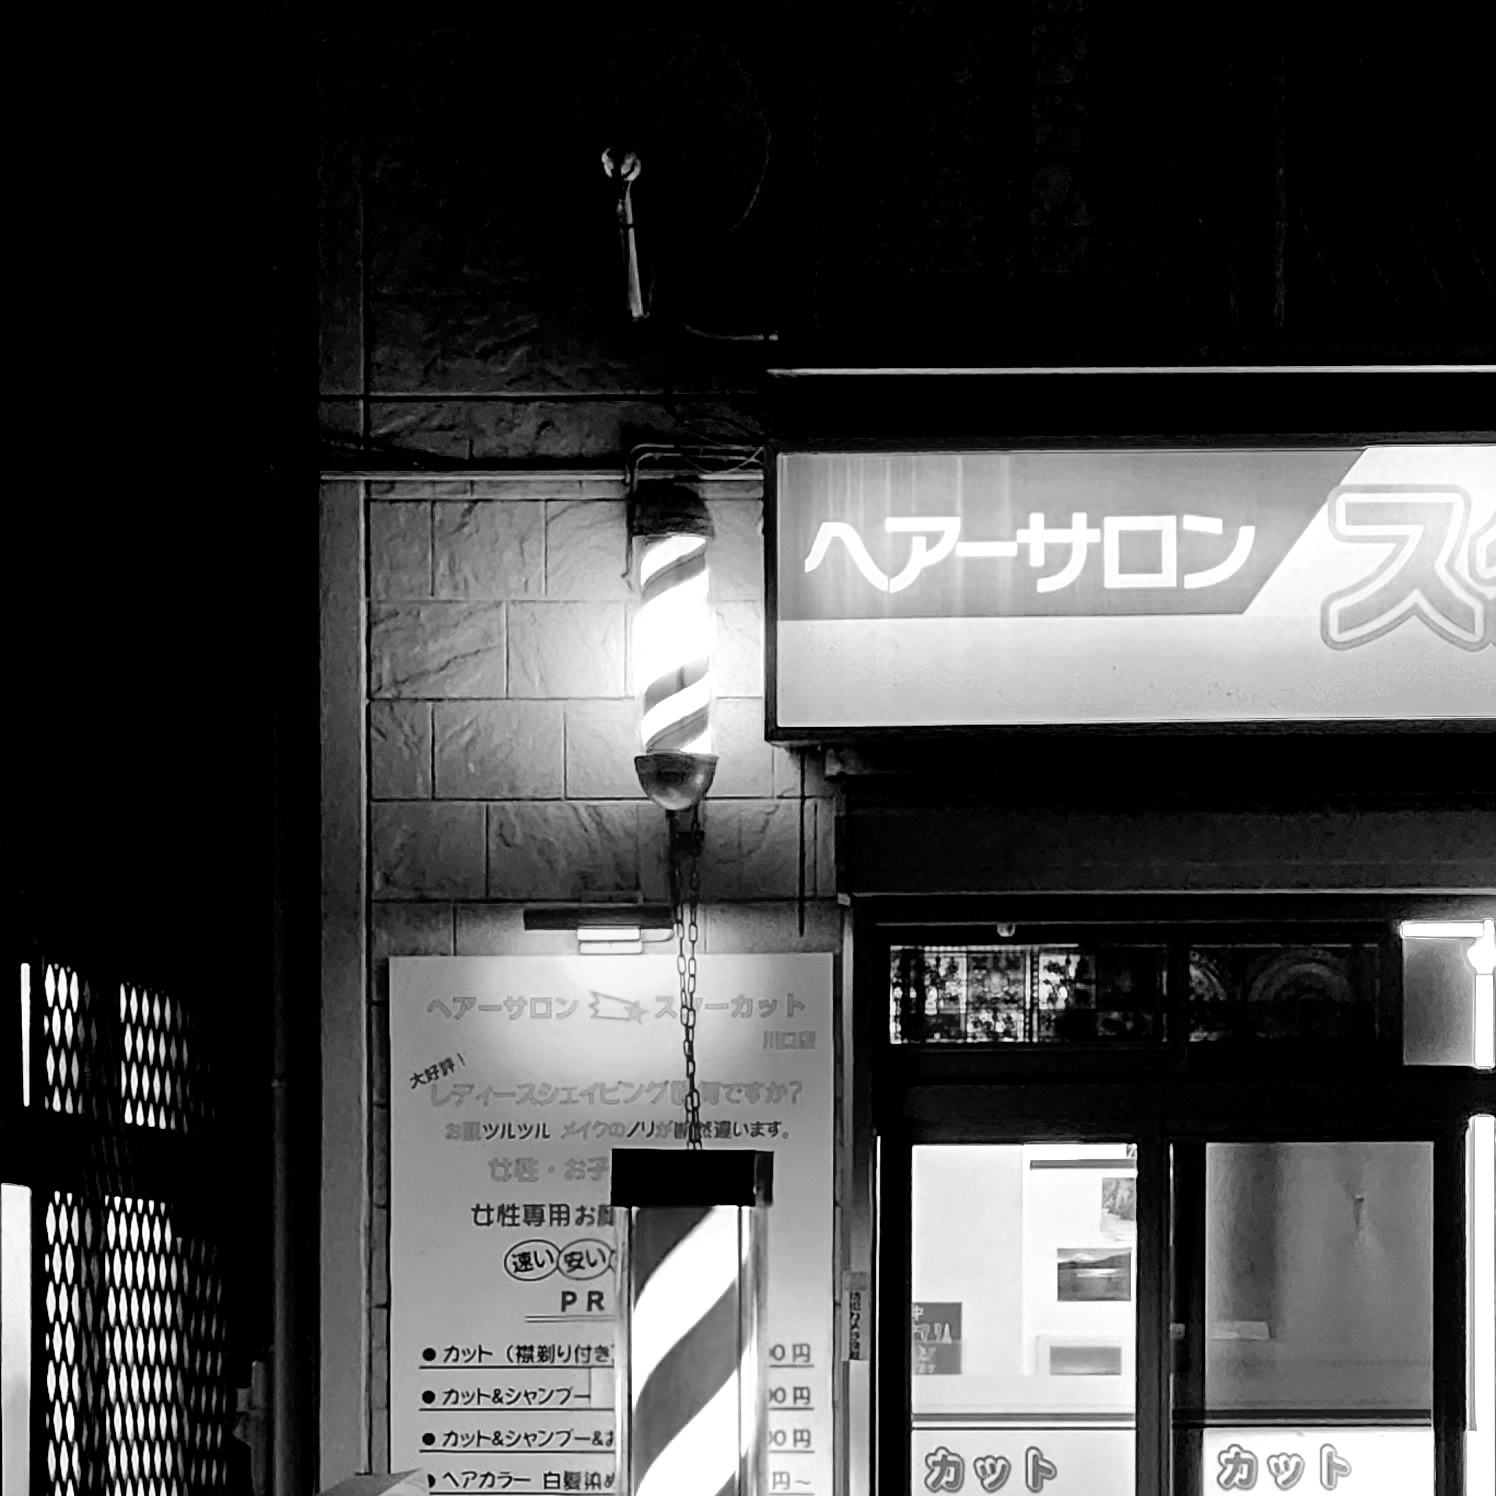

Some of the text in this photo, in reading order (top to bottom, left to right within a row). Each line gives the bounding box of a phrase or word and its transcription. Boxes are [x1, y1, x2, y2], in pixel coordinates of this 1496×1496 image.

[805, 512, 1255, 593] ヘアーサロン
[426, 995, 580, 1020] ヘアーサロン
[925, 1446, 1057, 1493] カット
[1217, 1444, 1352, 1491] カット
